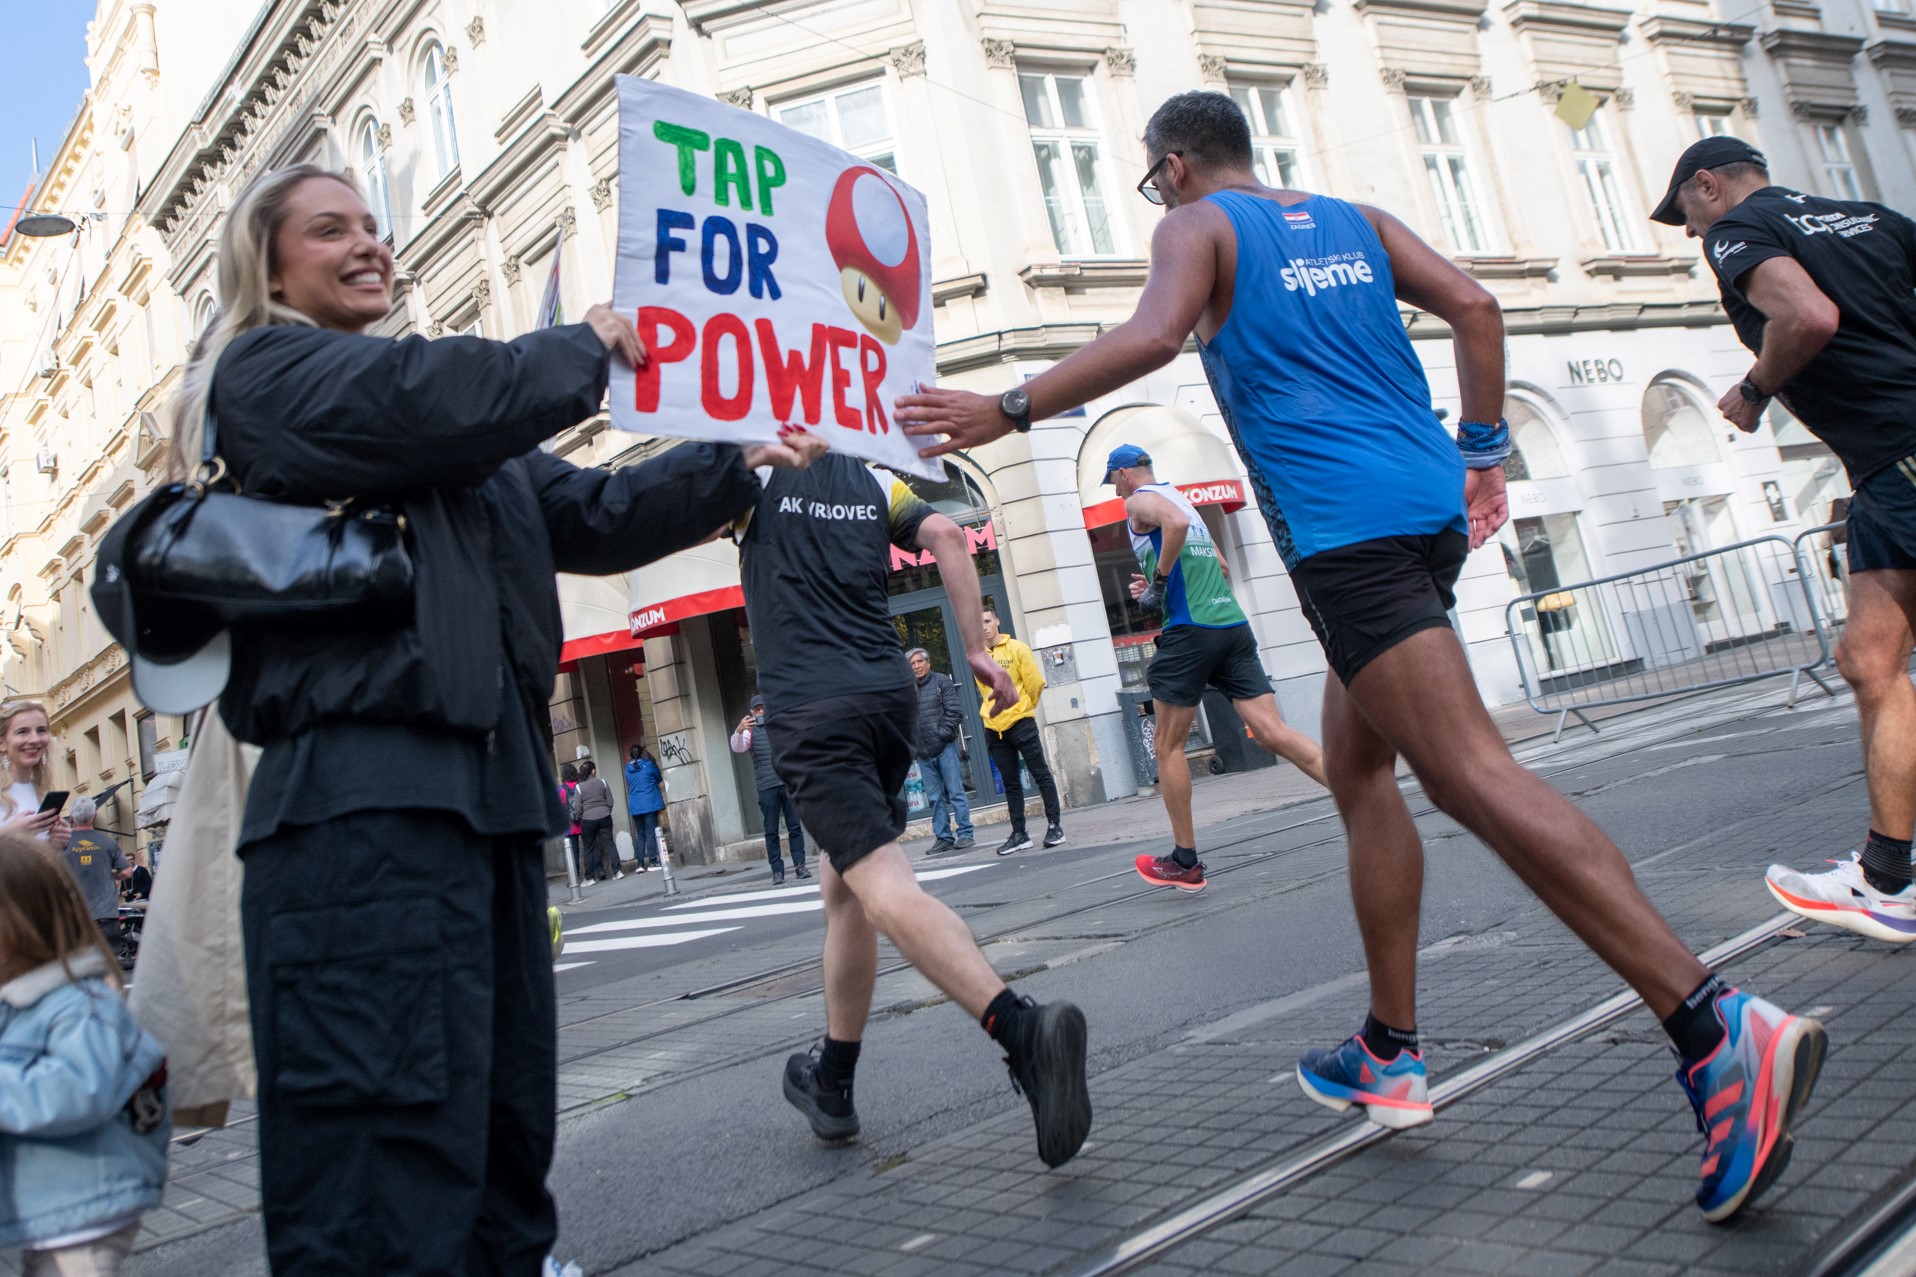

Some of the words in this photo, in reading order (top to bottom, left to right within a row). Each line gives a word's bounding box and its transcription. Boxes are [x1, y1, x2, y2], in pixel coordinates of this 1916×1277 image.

[653, 119, 787, 216] TAP
[655, 208, 782, 300] FOR
[1304, 254, 1341, 266] ATLETSKI
[1342, 251, 1365, 261] KLUB
[635, 306, 889, 435] POWER
[1566, 357, 1624, 384] NEBO
[778, 496, 803, 514] AK
